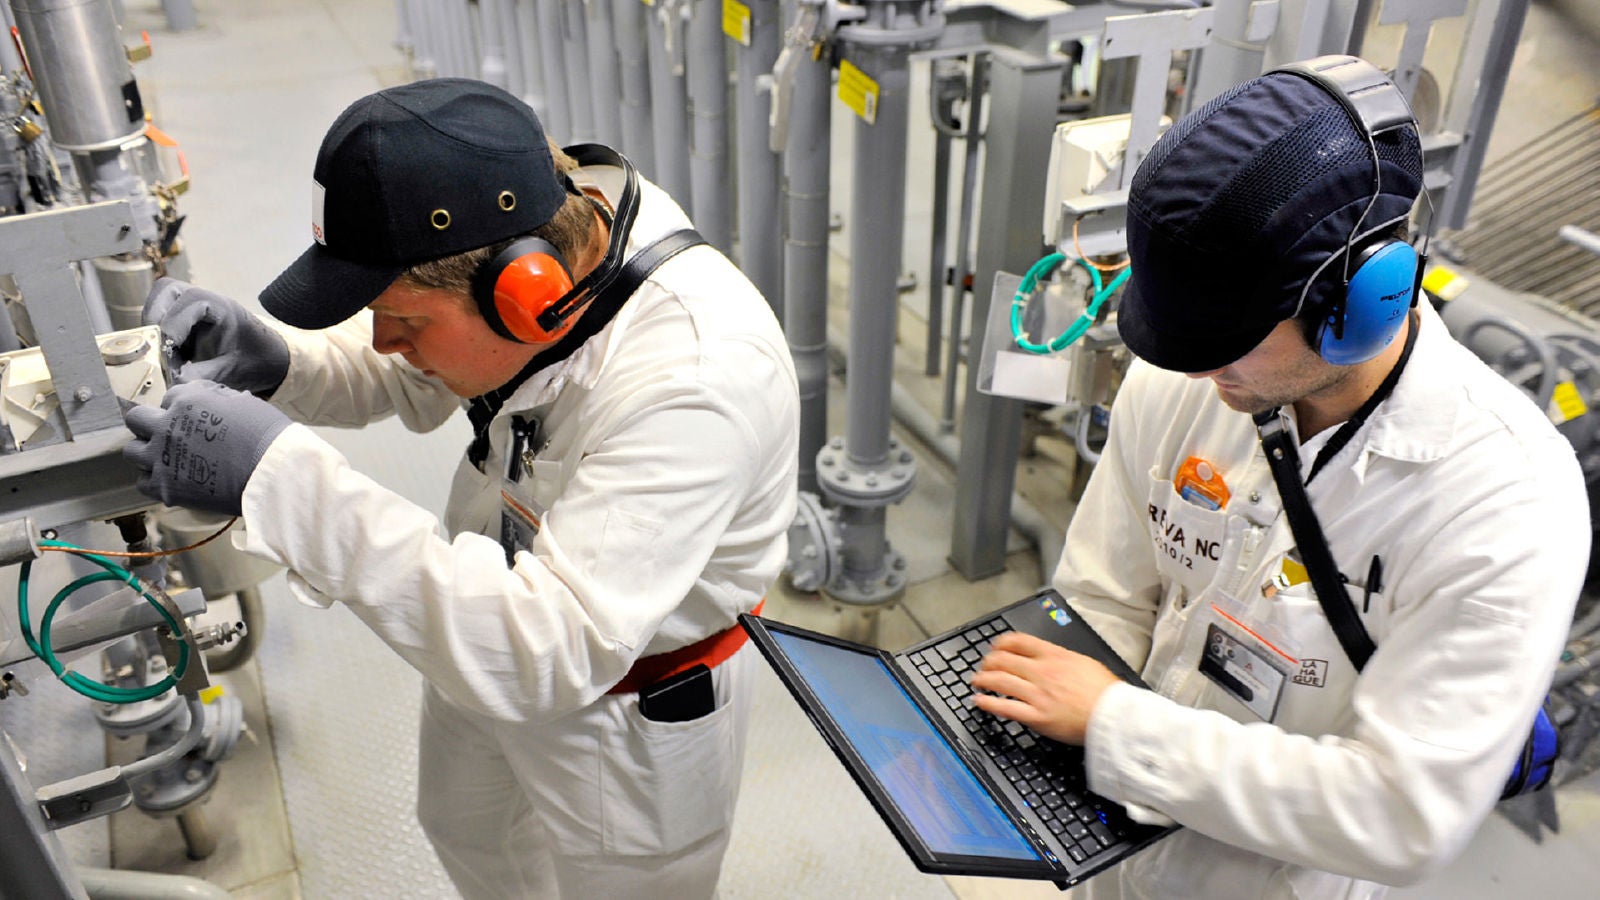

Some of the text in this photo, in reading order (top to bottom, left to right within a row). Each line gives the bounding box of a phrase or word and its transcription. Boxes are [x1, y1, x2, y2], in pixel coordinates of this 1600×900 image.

[204, 413, 223, 442] CE
[1195, 537, 1221, 562] NC
[1302, 660, 1317, 669] LA
[1299, 668, 1316, 676] HA
[1293, 674, 1320, 686] GUE
